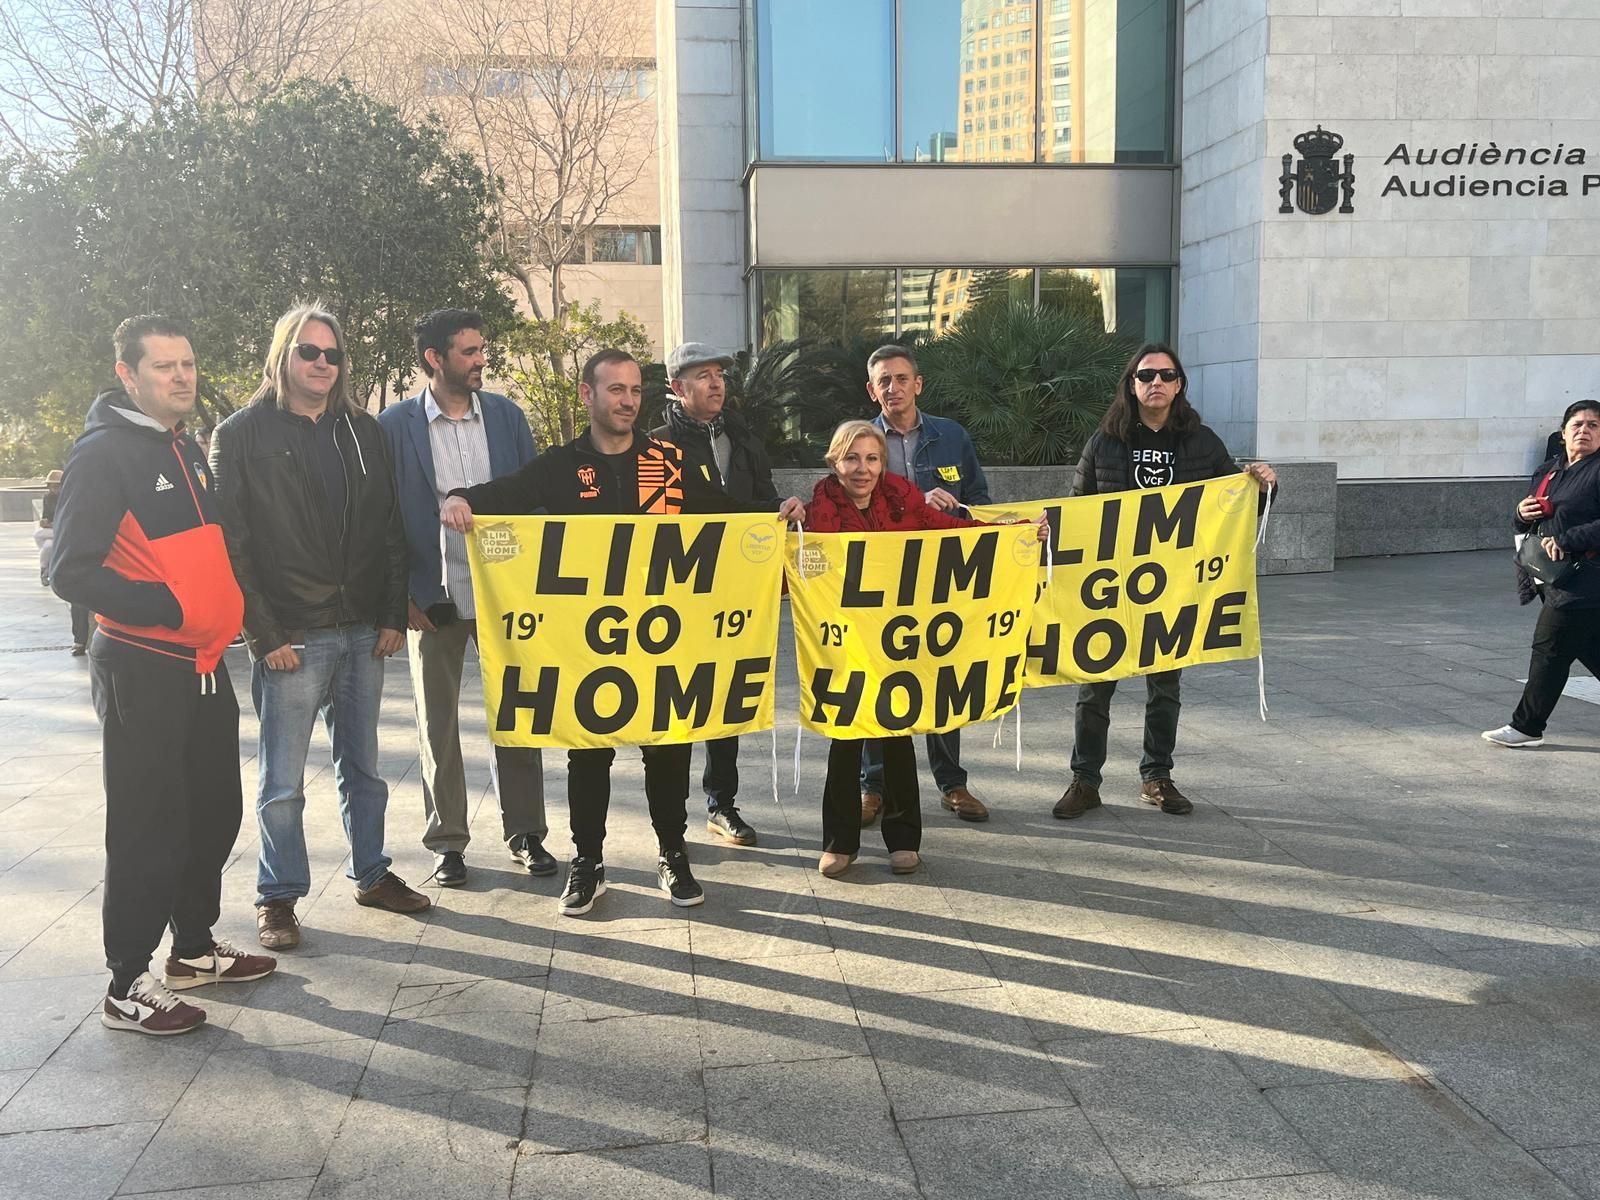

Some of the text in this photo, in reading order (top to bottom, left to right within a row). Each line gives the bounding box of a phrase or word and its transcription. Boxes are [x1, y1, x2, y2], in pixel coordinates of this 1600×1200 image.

[1381, 175, 1569, 197] Audiencia
[1384, 142, 1586, 165] Audiència
[1143, 476, 1164, 486] VCF
[1039, 484, 1206, 567] LIM
[535, 521, 727, 596] LIM
[840, 531, 999, 608] LIM
[1080, 561, 1168, 611] GO
[1194, 555, 1230, 583] 19'
[501, 604, 753, 655] 19' GO 19'
[881, 611, 963, 661] GO
[987, 609, 1021, 638] 19'
[1022, 592, 1246, 675] HOME
[495, 656, 772, 735] HOME
[810, 654, 1022, 731] HOME
